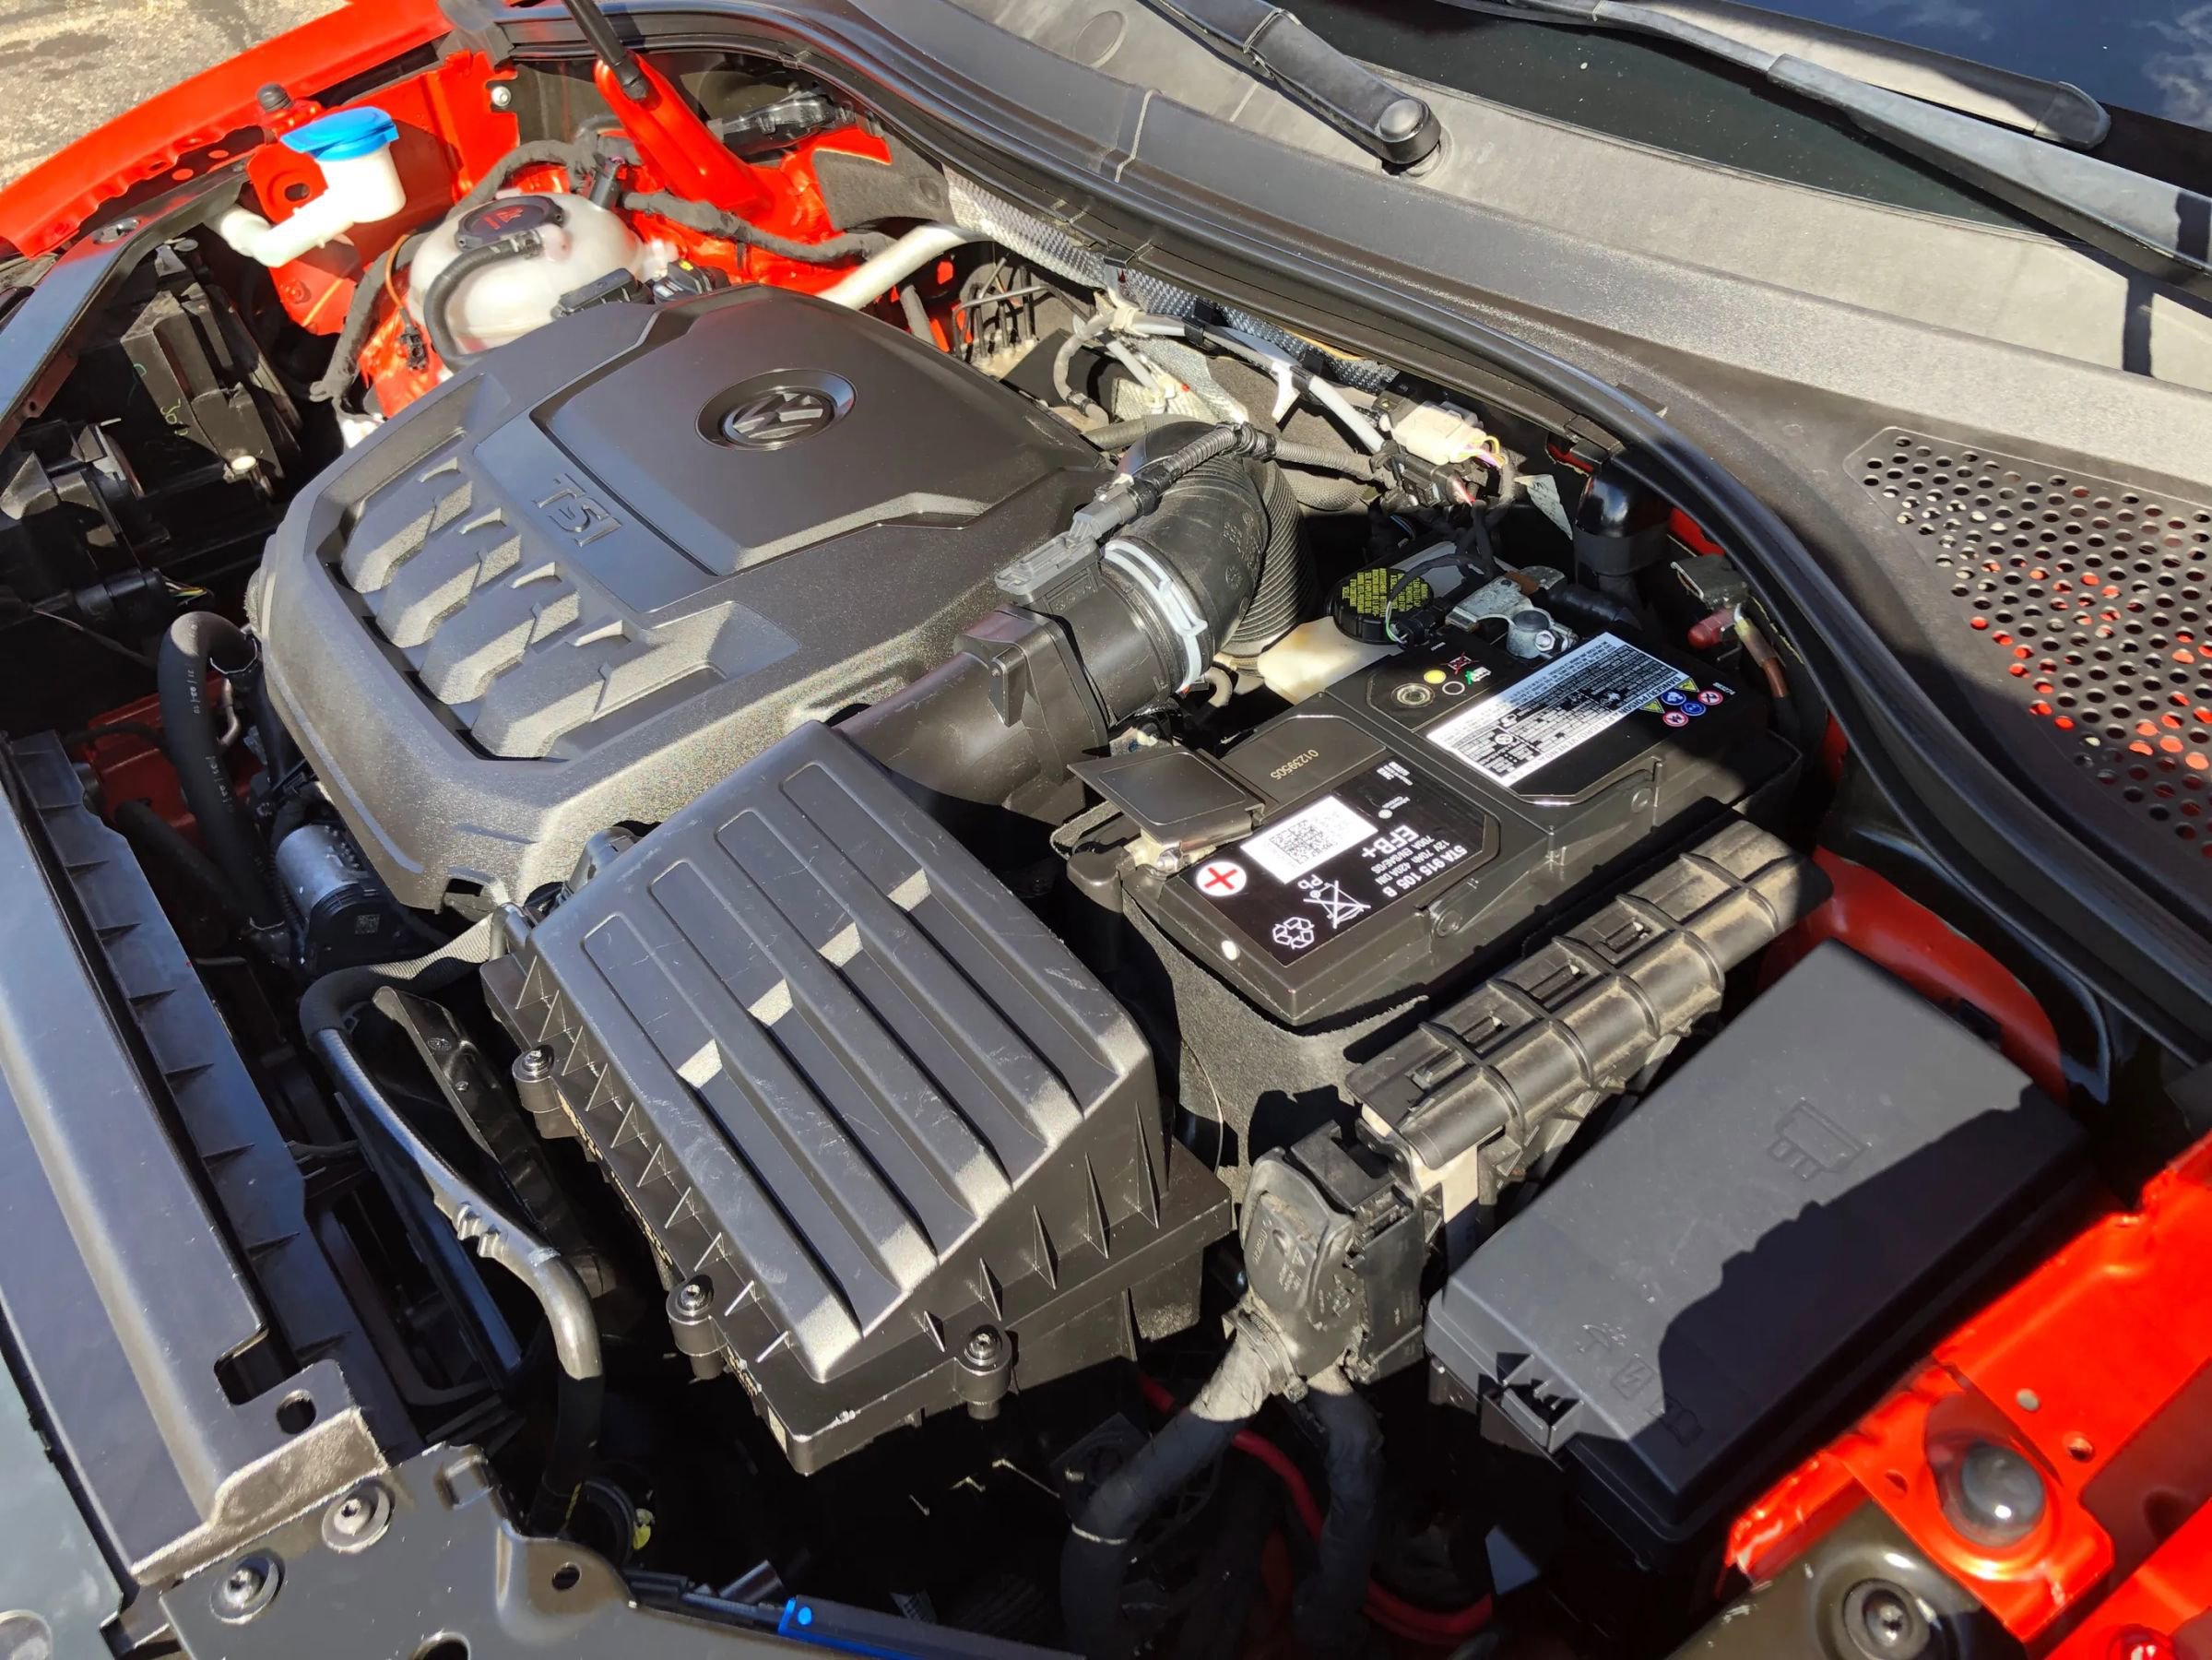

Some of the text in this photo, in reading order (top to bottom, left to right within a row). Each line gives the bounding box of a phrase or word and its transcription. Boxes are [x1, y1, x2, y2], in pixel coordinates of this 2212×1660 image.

[530, 472, 622, 547] TSI
[1617, 676, 1682, 714] DANGER/POISON
[1271, 750, 1319, 780] 01239505
[1362, 824, 1419, 858] EFB+
[1411, 836, 1435, 850] 700A
[1375, 840, 1450, 885] 12V 70Ah 420A DIN
[1382, 845, 1468, 897] 5TA 915 105 B
[1297, 874, 1323, 889] Pb
